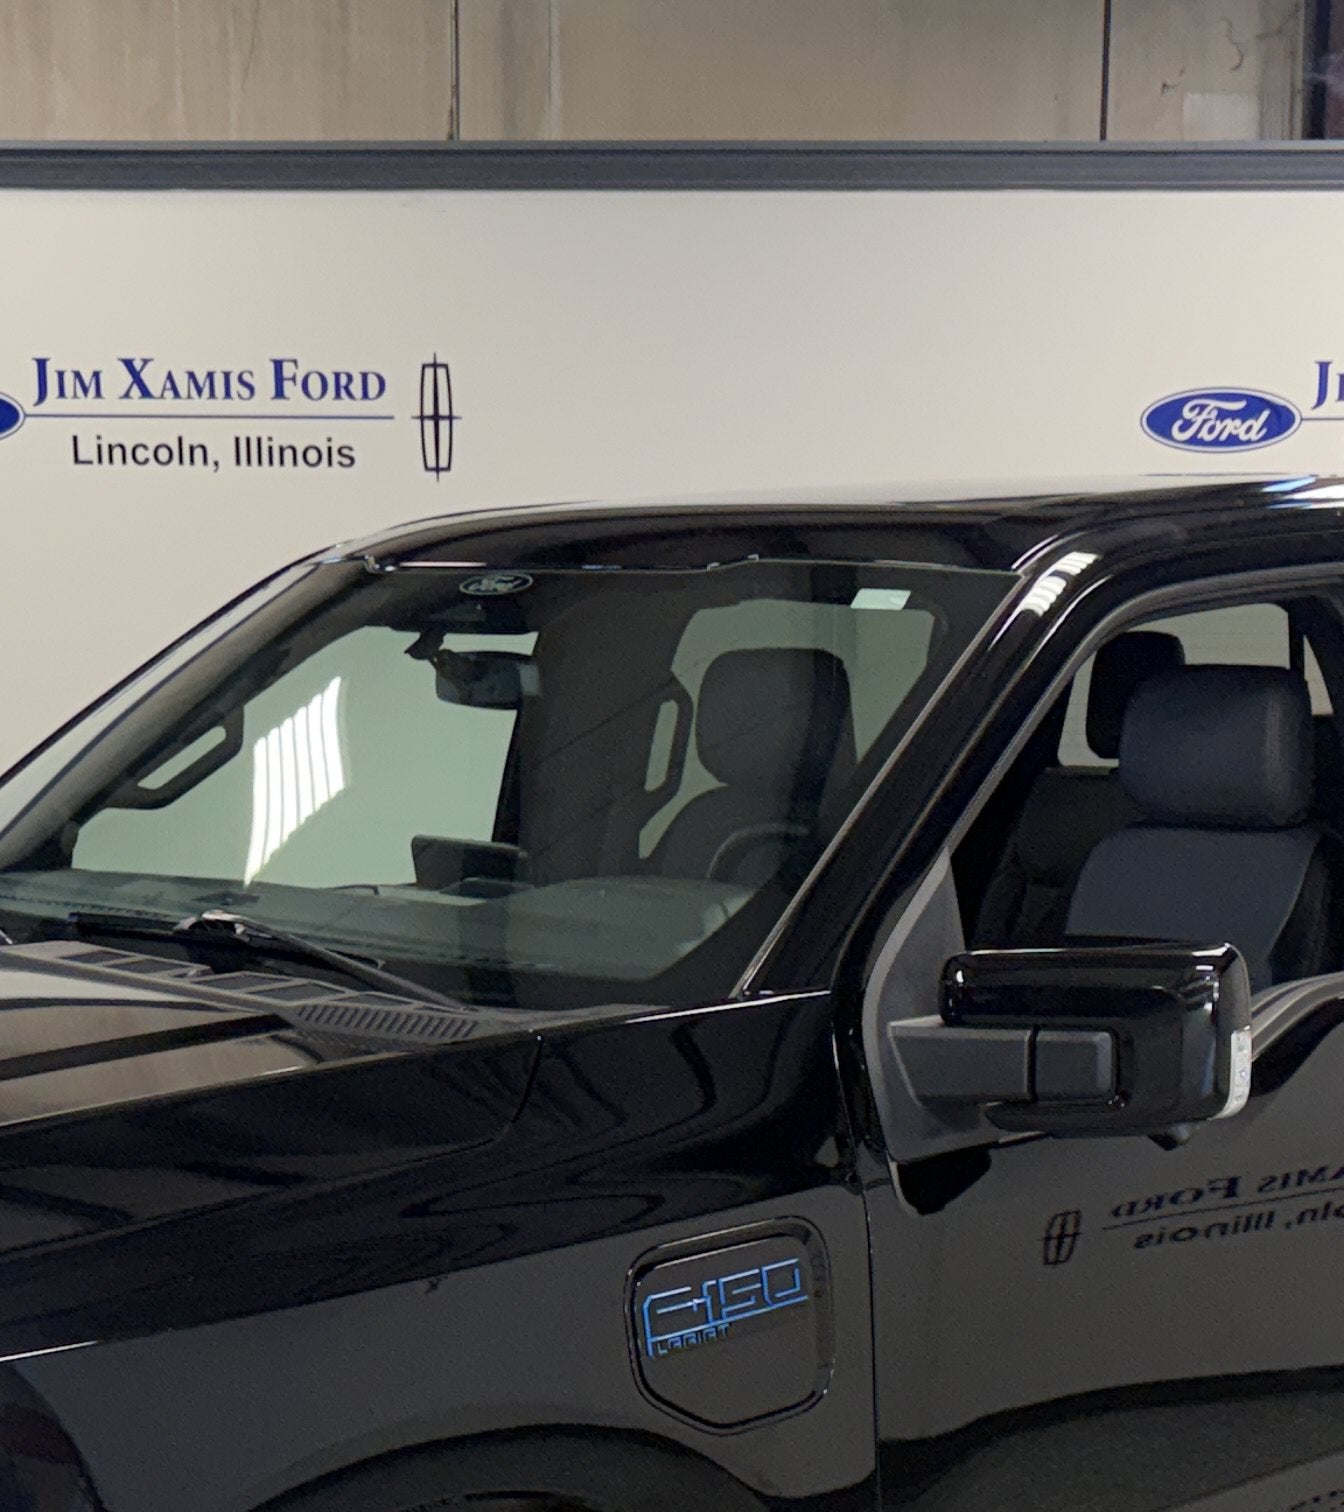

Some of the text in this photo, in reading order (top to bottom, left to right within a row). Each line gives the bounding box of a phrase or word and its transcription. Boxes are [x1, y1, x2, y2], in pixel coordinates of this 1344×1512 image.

[32, 357, 387, 407] JIM XAMIS FORD
[1170, 398, 1268, 443] Ford
[72, 434, 356, 473] Lincoln, Illinois
[656, 1322, 732, 1355] LARIAT
